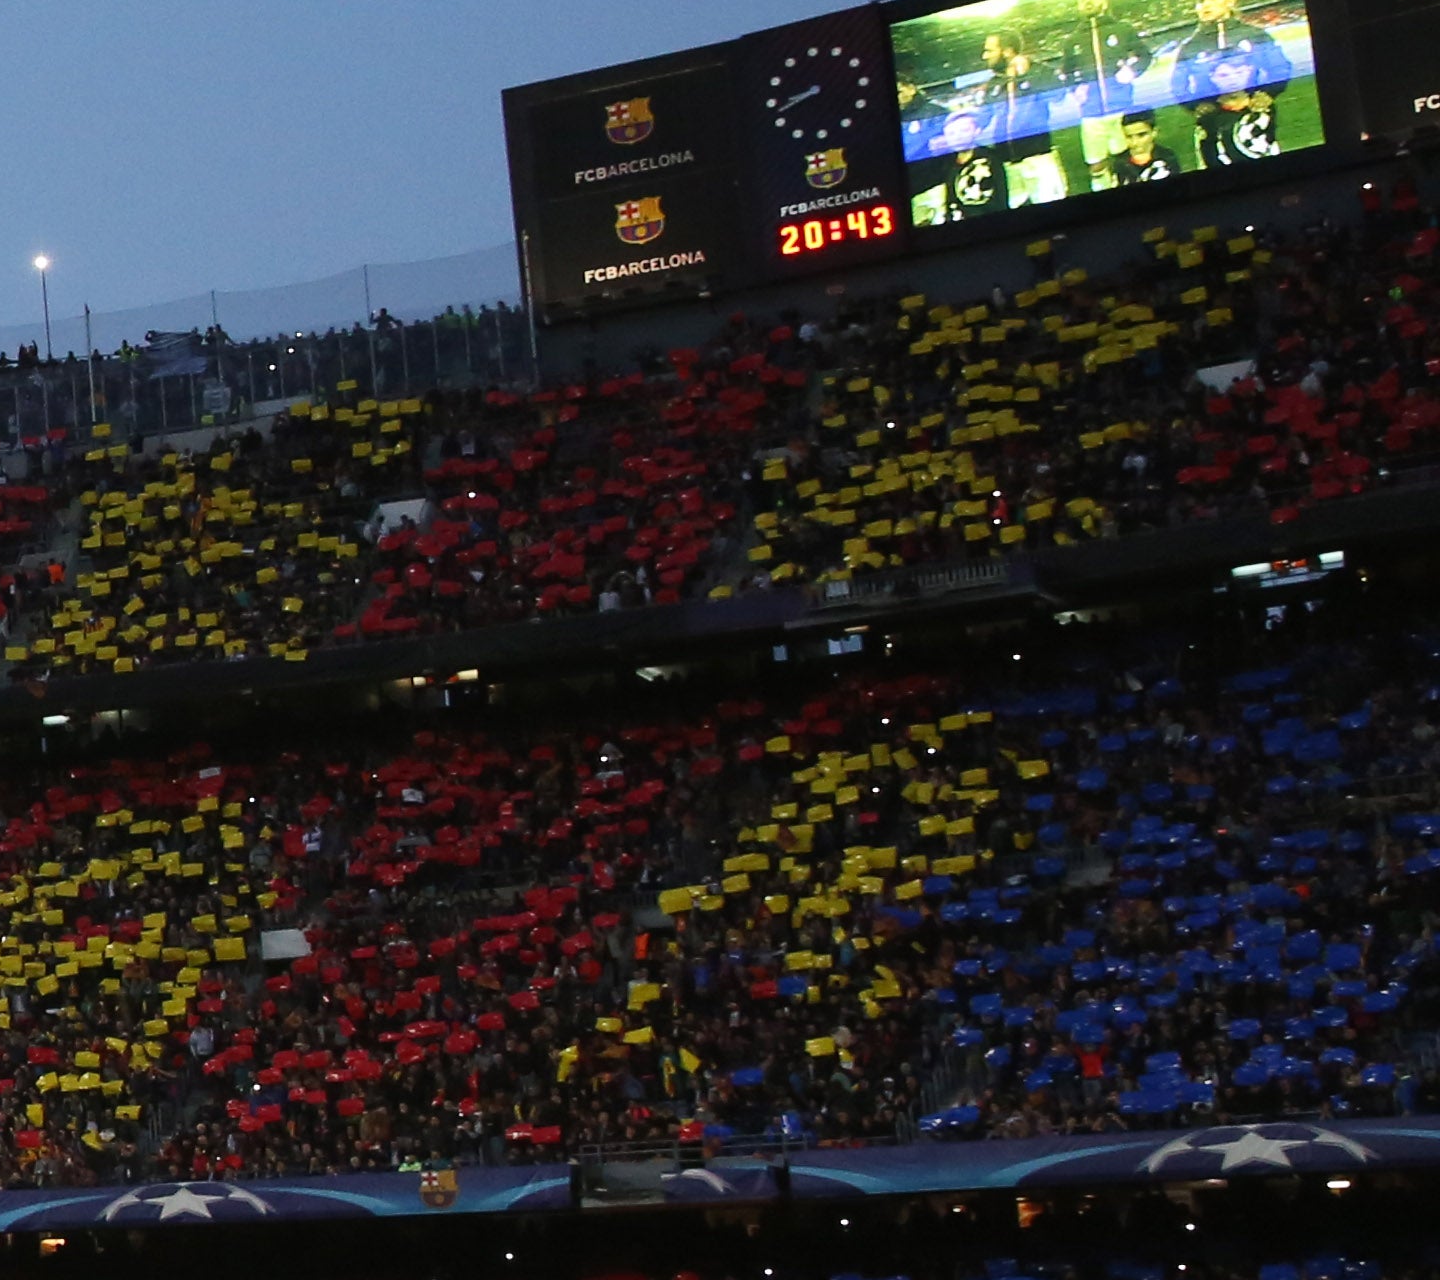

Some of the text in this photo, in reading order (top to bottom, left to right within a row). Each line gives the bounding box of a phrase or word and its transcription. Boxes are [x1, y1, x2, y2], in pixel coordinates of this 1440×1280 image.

[574, 150, 694, 184] FCBARCELONA
[780, 187, 880, 217] FCBARCELONA
[780, 206, 893, 255] 20:43
[584, 250, 705, 284] FCBARCELONA
